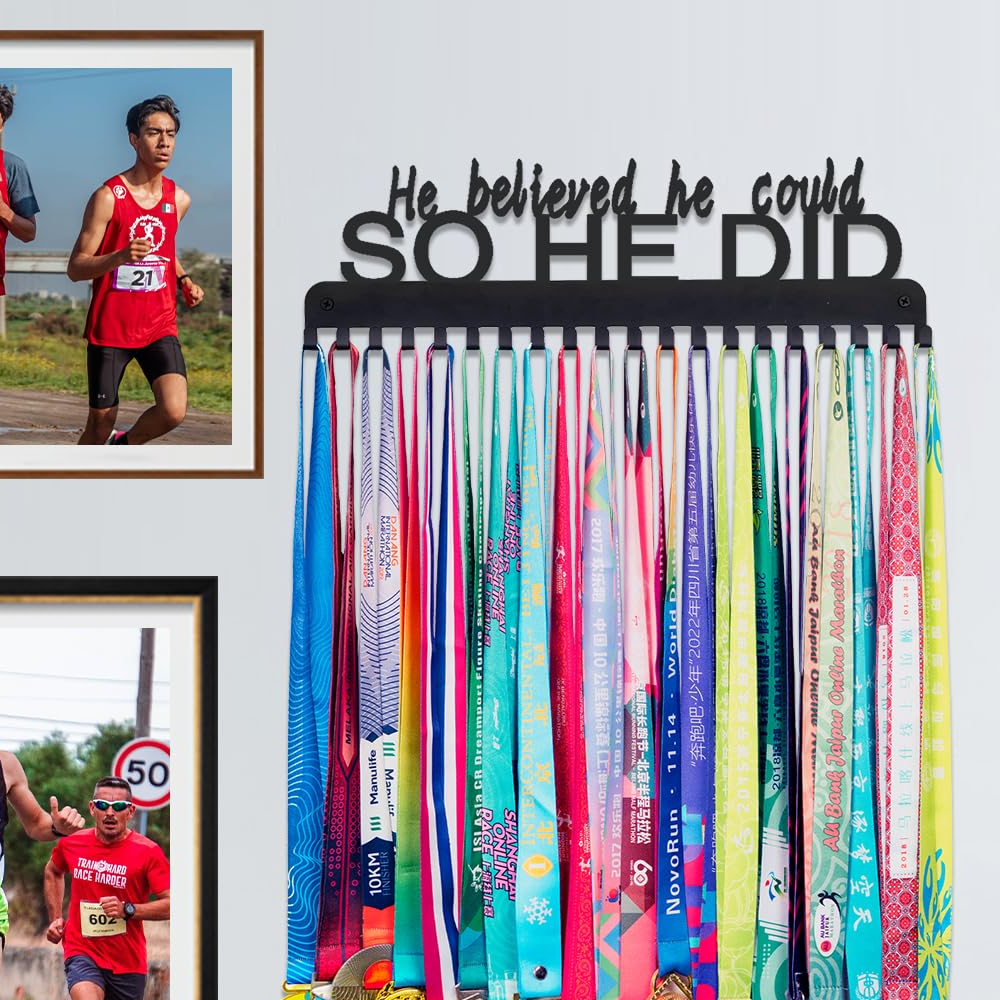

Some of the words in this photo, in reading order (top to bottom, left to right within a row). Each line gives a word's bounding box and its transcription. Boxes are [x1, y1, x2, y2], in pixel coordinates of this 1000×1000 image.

[386, 164, 438, 220] He
[466, 157, 638, 219] believed
[665, 158, 715, 217] he
[750, 156, 866, 217] could
[340, 210, 494, 283] SO
[536, 213, 680, 282] HE
[722, 213, 903, 281] DID
[131, 270, 153, 287] 21
[491, 552, 501, 620] ONLINE
[829, 549, 845, 643] Marathon
[475, 631, 483, 680] Figure
[667, 604, 678, 679] World
[827, 646, 845, 706] Online
[474, 684, 483, 765] Dreamport
[520, 640, 535, 845] INTERCONTINENTAL
[667, 713, 677, 772] 11.14
[825, 709, 846, 767] Jaipur
[127, 759, 170, 787] 50
[368, 749, 379, 805] Manulife
[473, 770, 482, 790] CR
[823, 770, 846, 819] Bank
[473, 794, 482, 827] Asia
[481, 807, 494, 855] RACE
[73, 868, 94, 881] RACE
[95, 872, 127, 888] HARDER
[368, 852, 382, 896] 10KM
[380, 851, 391, 896] FINISHER
[493, 822, 509, 891] ONLINE
[503, 808, 518, 902] SHANGHAI
[666, 808, 681, 915] NovoRun
